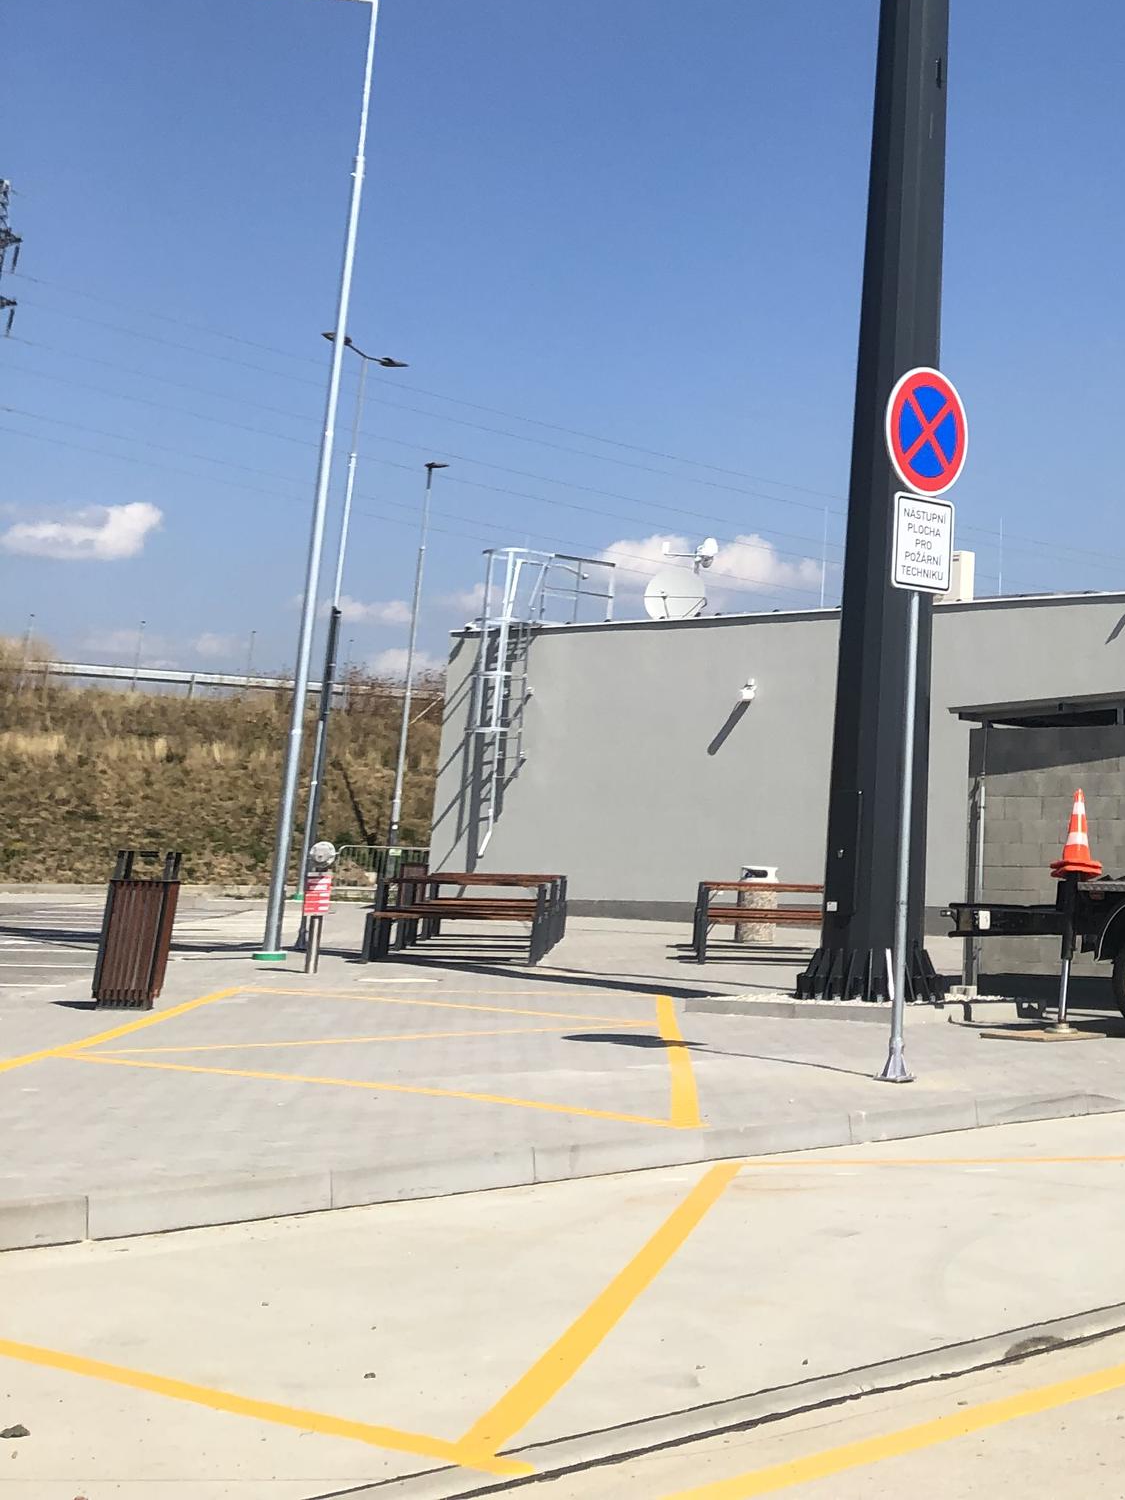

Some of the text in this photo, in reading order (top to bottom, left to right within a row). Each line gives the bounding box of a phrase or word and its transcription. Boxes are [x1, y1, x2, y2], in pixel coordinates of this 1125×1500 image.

[903, 506, 946, 524] NÁSTUPNÍ
[907, 522, 941, 537] PLOCHA
[915, 538, 932, 550] PRO
[904, 551, 942, 566] POŽÁRNÍ
[901, 564, 943, 580] TECHNIKU
